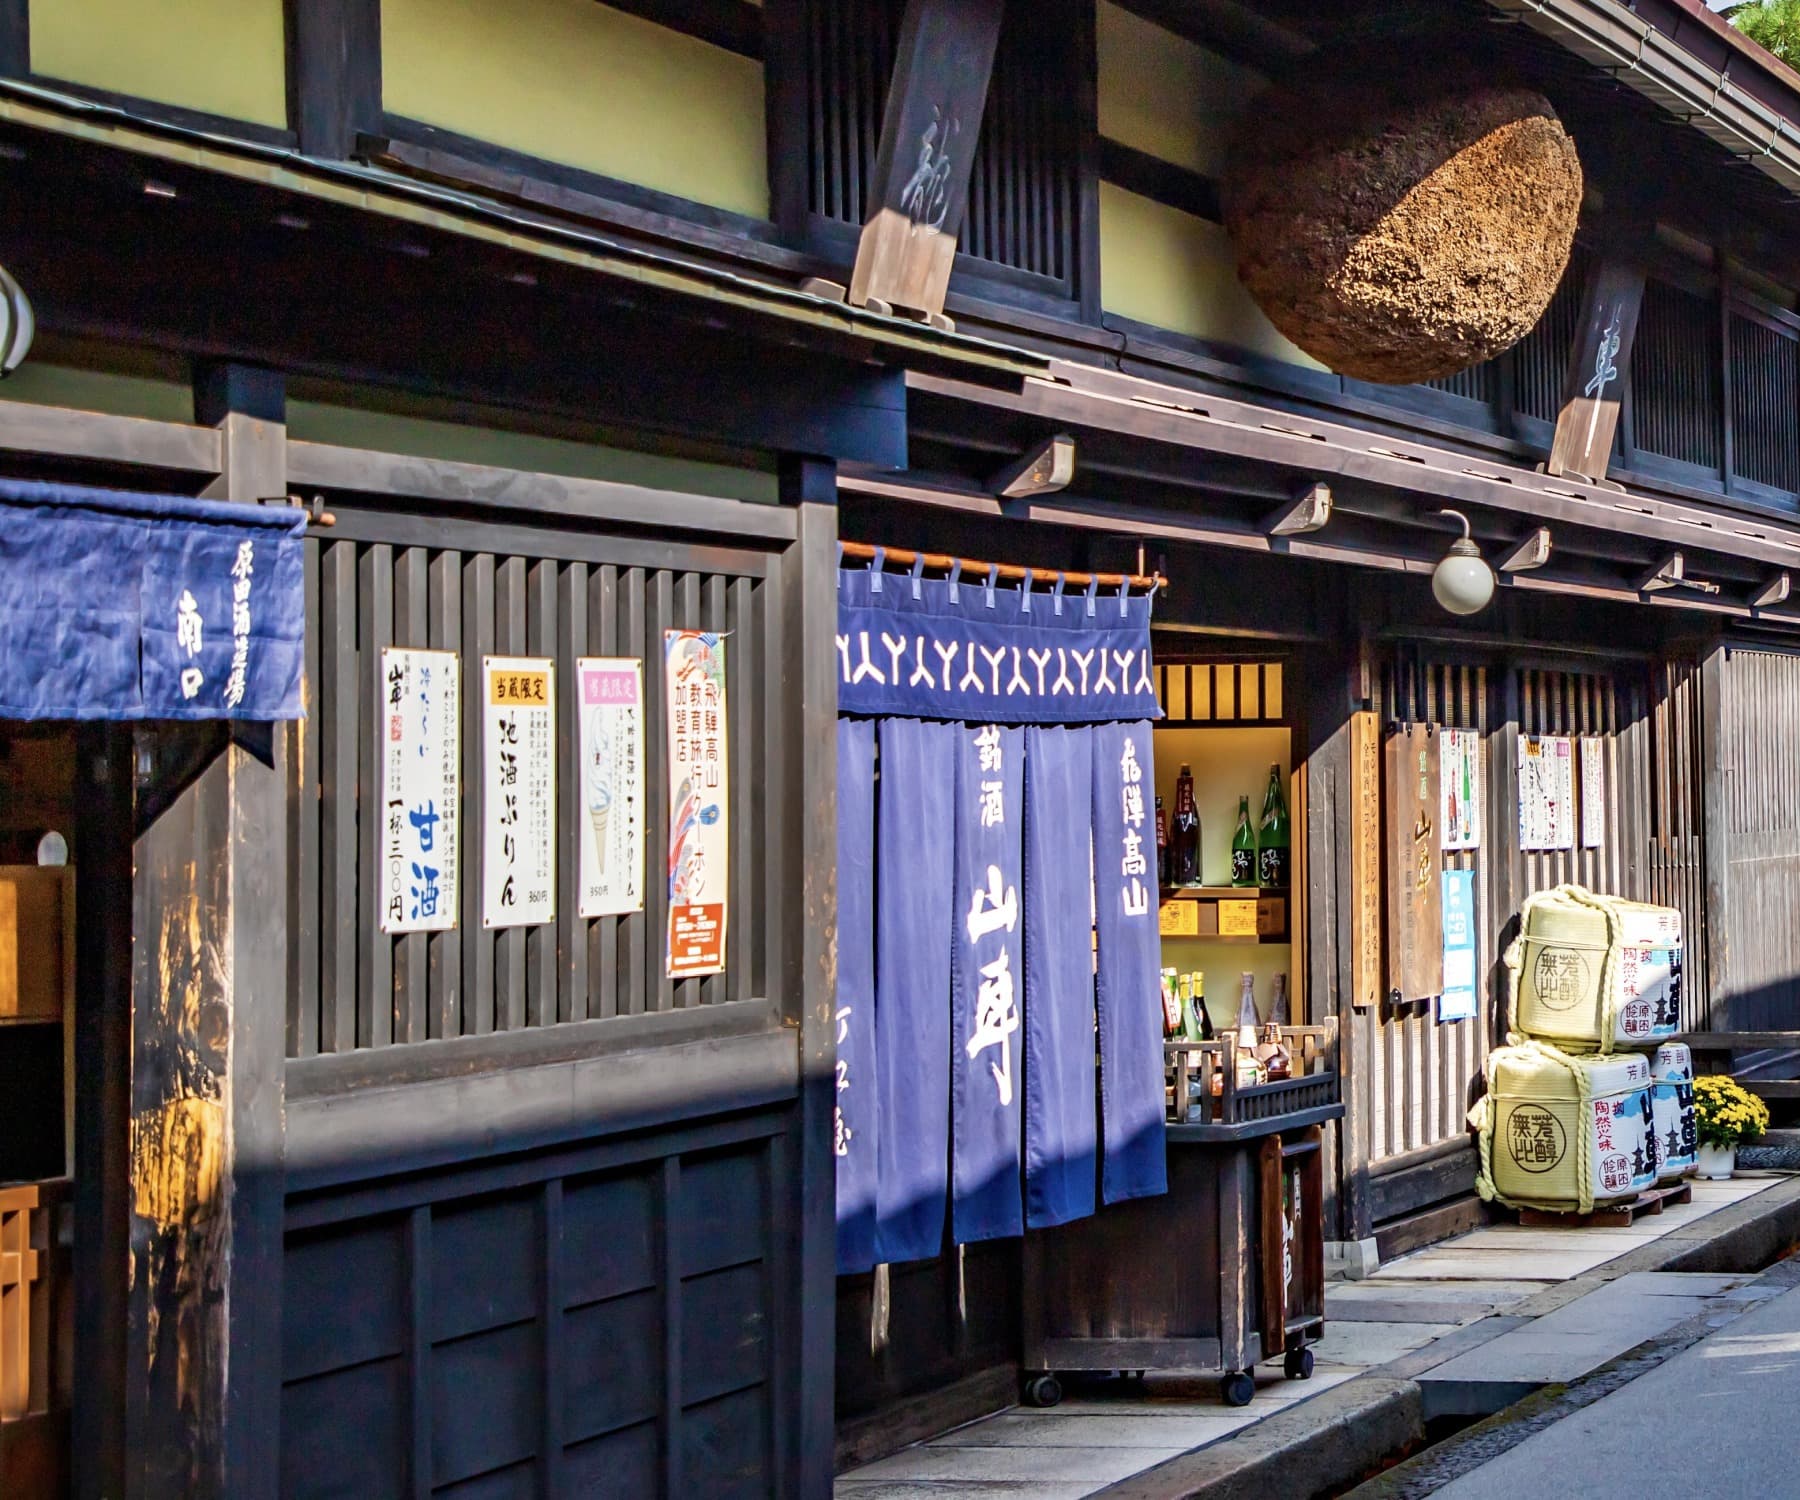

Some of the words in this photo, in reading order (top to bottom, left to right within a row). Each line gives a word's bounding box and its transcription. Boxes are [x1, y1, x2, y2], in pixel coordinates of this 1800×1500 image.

[176, 588, 205, 700] 南口
[223, 540, 254, 709] 原田酒造場
[388, 664, 404, 711] 山車
[497, 676, 544, 700] 当蔵限定
[590, 677, 635, 698] 当蔵限定
[675, 685, 687, 762] 加盟店
[705, 683, 719, 788] 飛騨高山
[499, 710, 519, 907] 地酒ぷりん
[690, 683, 706, 897] 教育旅行クーポン
[409, 799, 440, 920] 甘酒
[529, 890, 548, 903] 360円
[1415, 808, 1433, 905] 山車
[966, 864, 1020, 1107] 山車
[1674, 1066, 1698, 1163] 山車
